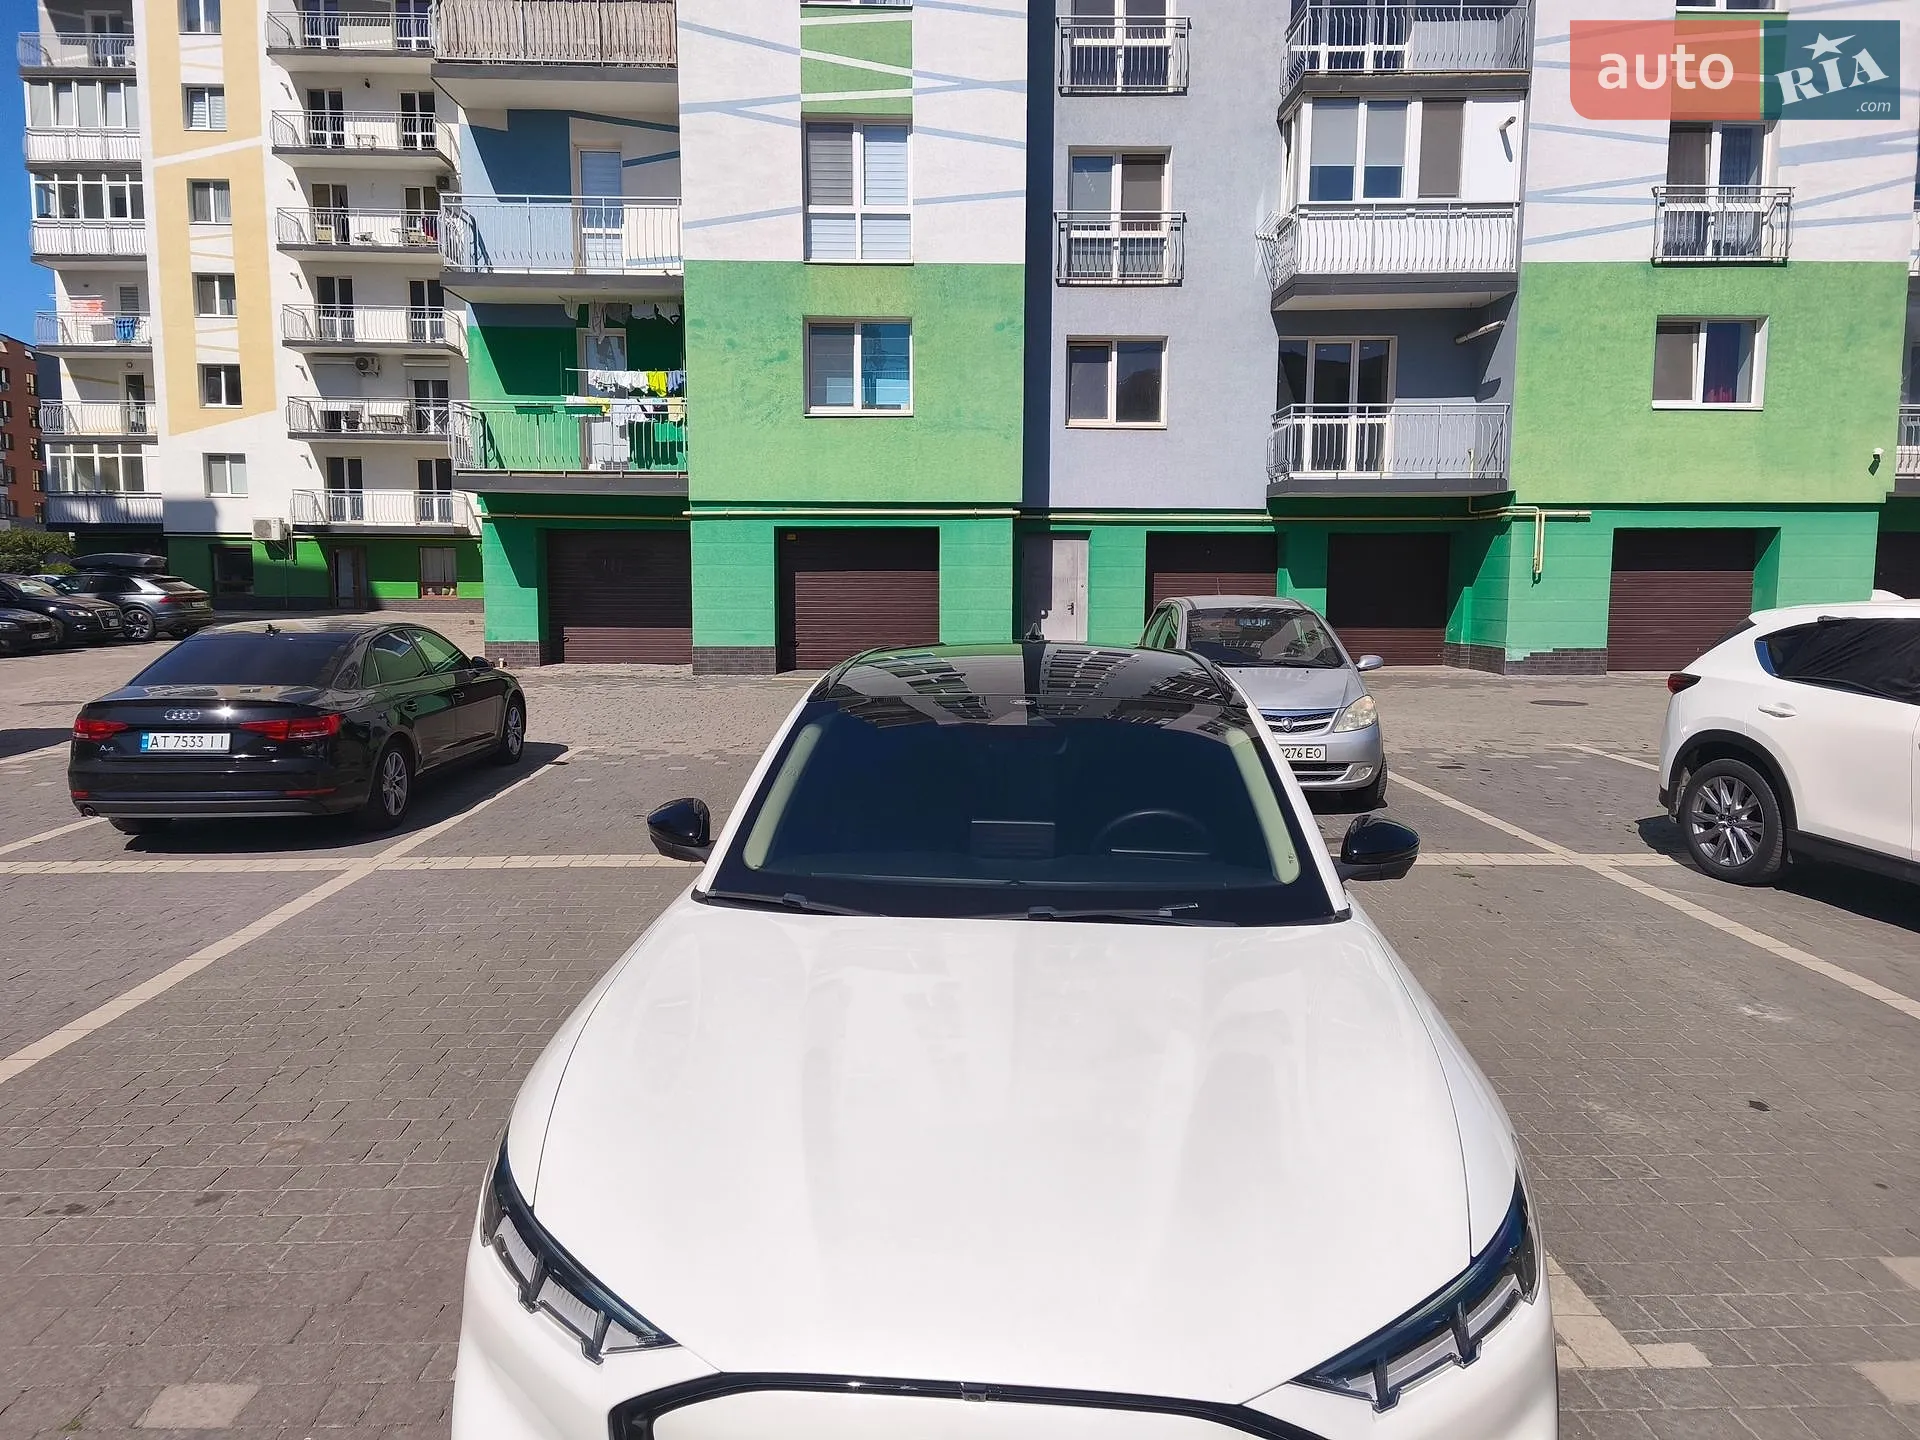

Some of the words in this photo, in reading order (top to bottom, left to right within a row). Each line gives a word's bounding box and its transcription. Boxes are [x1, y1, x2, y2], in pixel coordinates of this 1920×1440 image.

[150, 735, 170, 748] AT
[173, 735, 204, 748] 7533
[1305, 747, 1322, 759] EO
